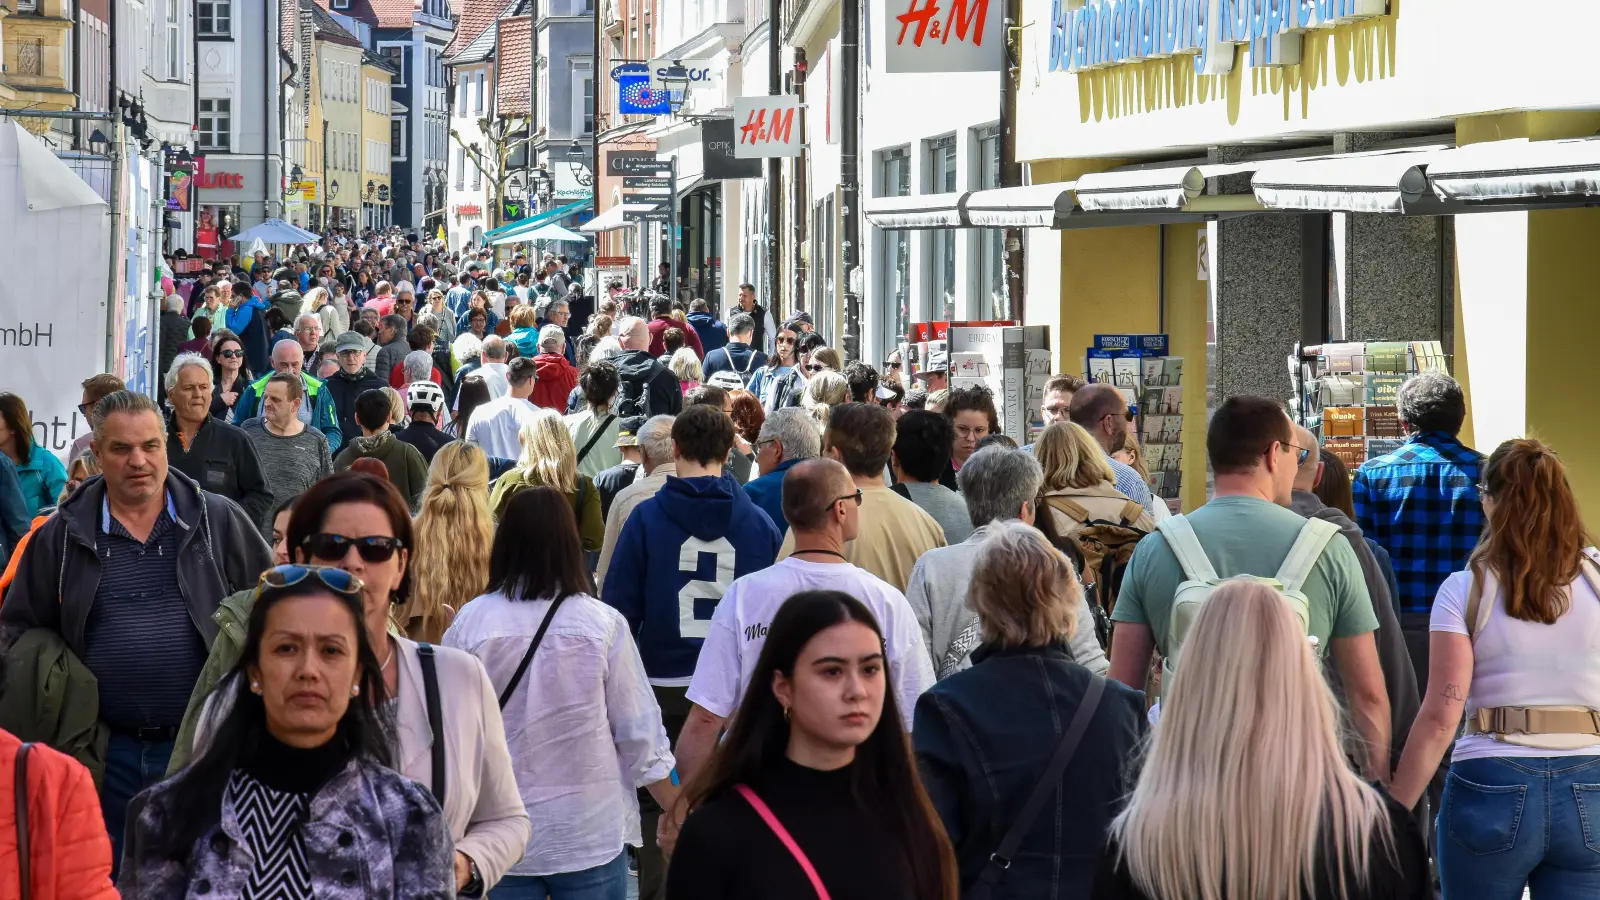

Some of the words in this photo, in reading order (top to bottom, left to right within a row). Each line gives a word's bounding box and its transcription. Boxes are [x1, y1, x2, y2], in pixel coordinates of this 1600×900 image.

[896, 0, 989, 47] H&M
[740, 107, 795, 145] H&M
[709, 141, 731, 150] OPTIK
[678, 535, 737, 638] 2
[744, 623, 773, 642] Ma
